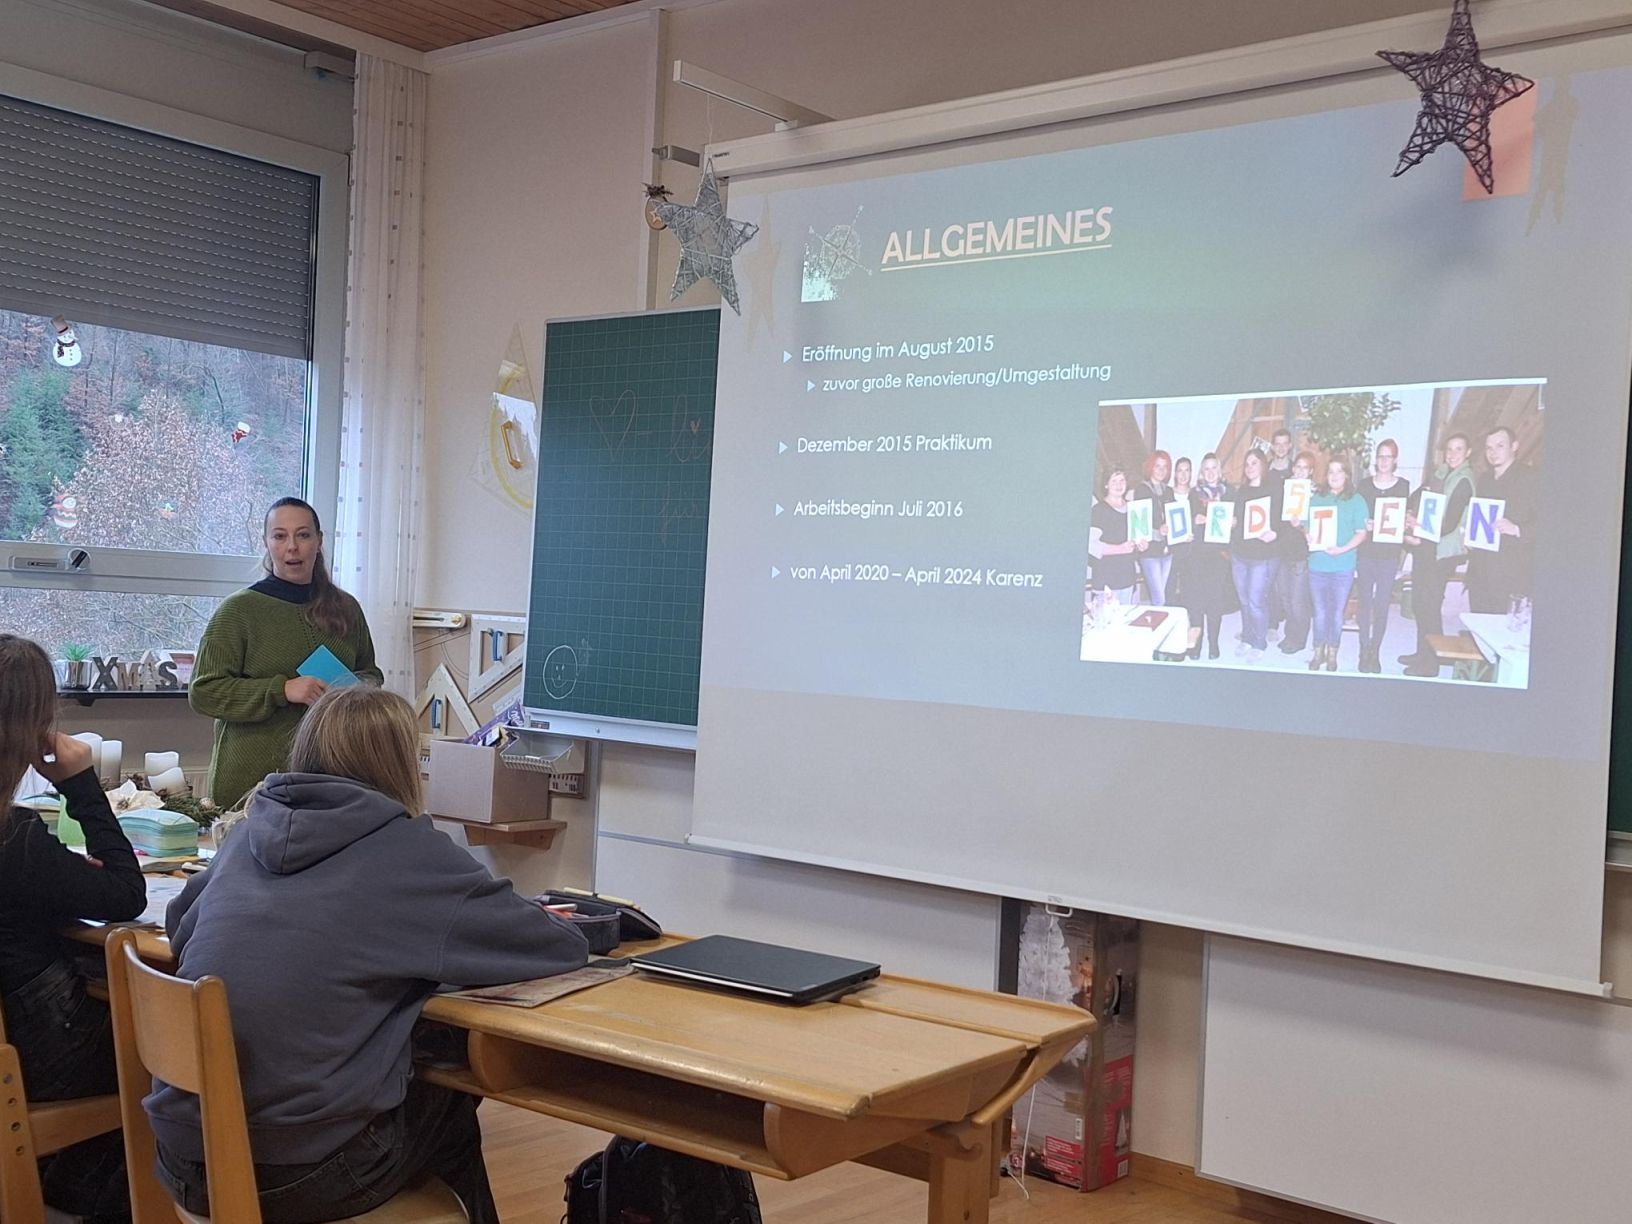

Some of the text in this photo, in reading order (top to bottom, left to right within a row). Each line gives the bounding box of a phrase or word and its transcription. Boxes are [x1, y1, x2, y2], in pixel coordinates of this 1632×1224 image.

[881, 206, 1113, 264] ALLGEMEINES
[802, 335, 994, 363] Eröffnung im August 2015
[822, 363, 1112, 393] zuvor große Renovierung/Umgestaltung
[797, 433, 992, 453] Dezember 2015 Praktikum
[793, 499, 963, 519] Arbeitsbeginn Juli 2016
[790, 566, 816, 580] von
[819, 564, 851, 584] April
[854, 565, 889, 581] 2020
[904, 567, 940, 586] April
[944, 568, 982, 585] 2024
[986, 569, 1043, 588] Karenz
[92, 650, 179, 690] XMAS
